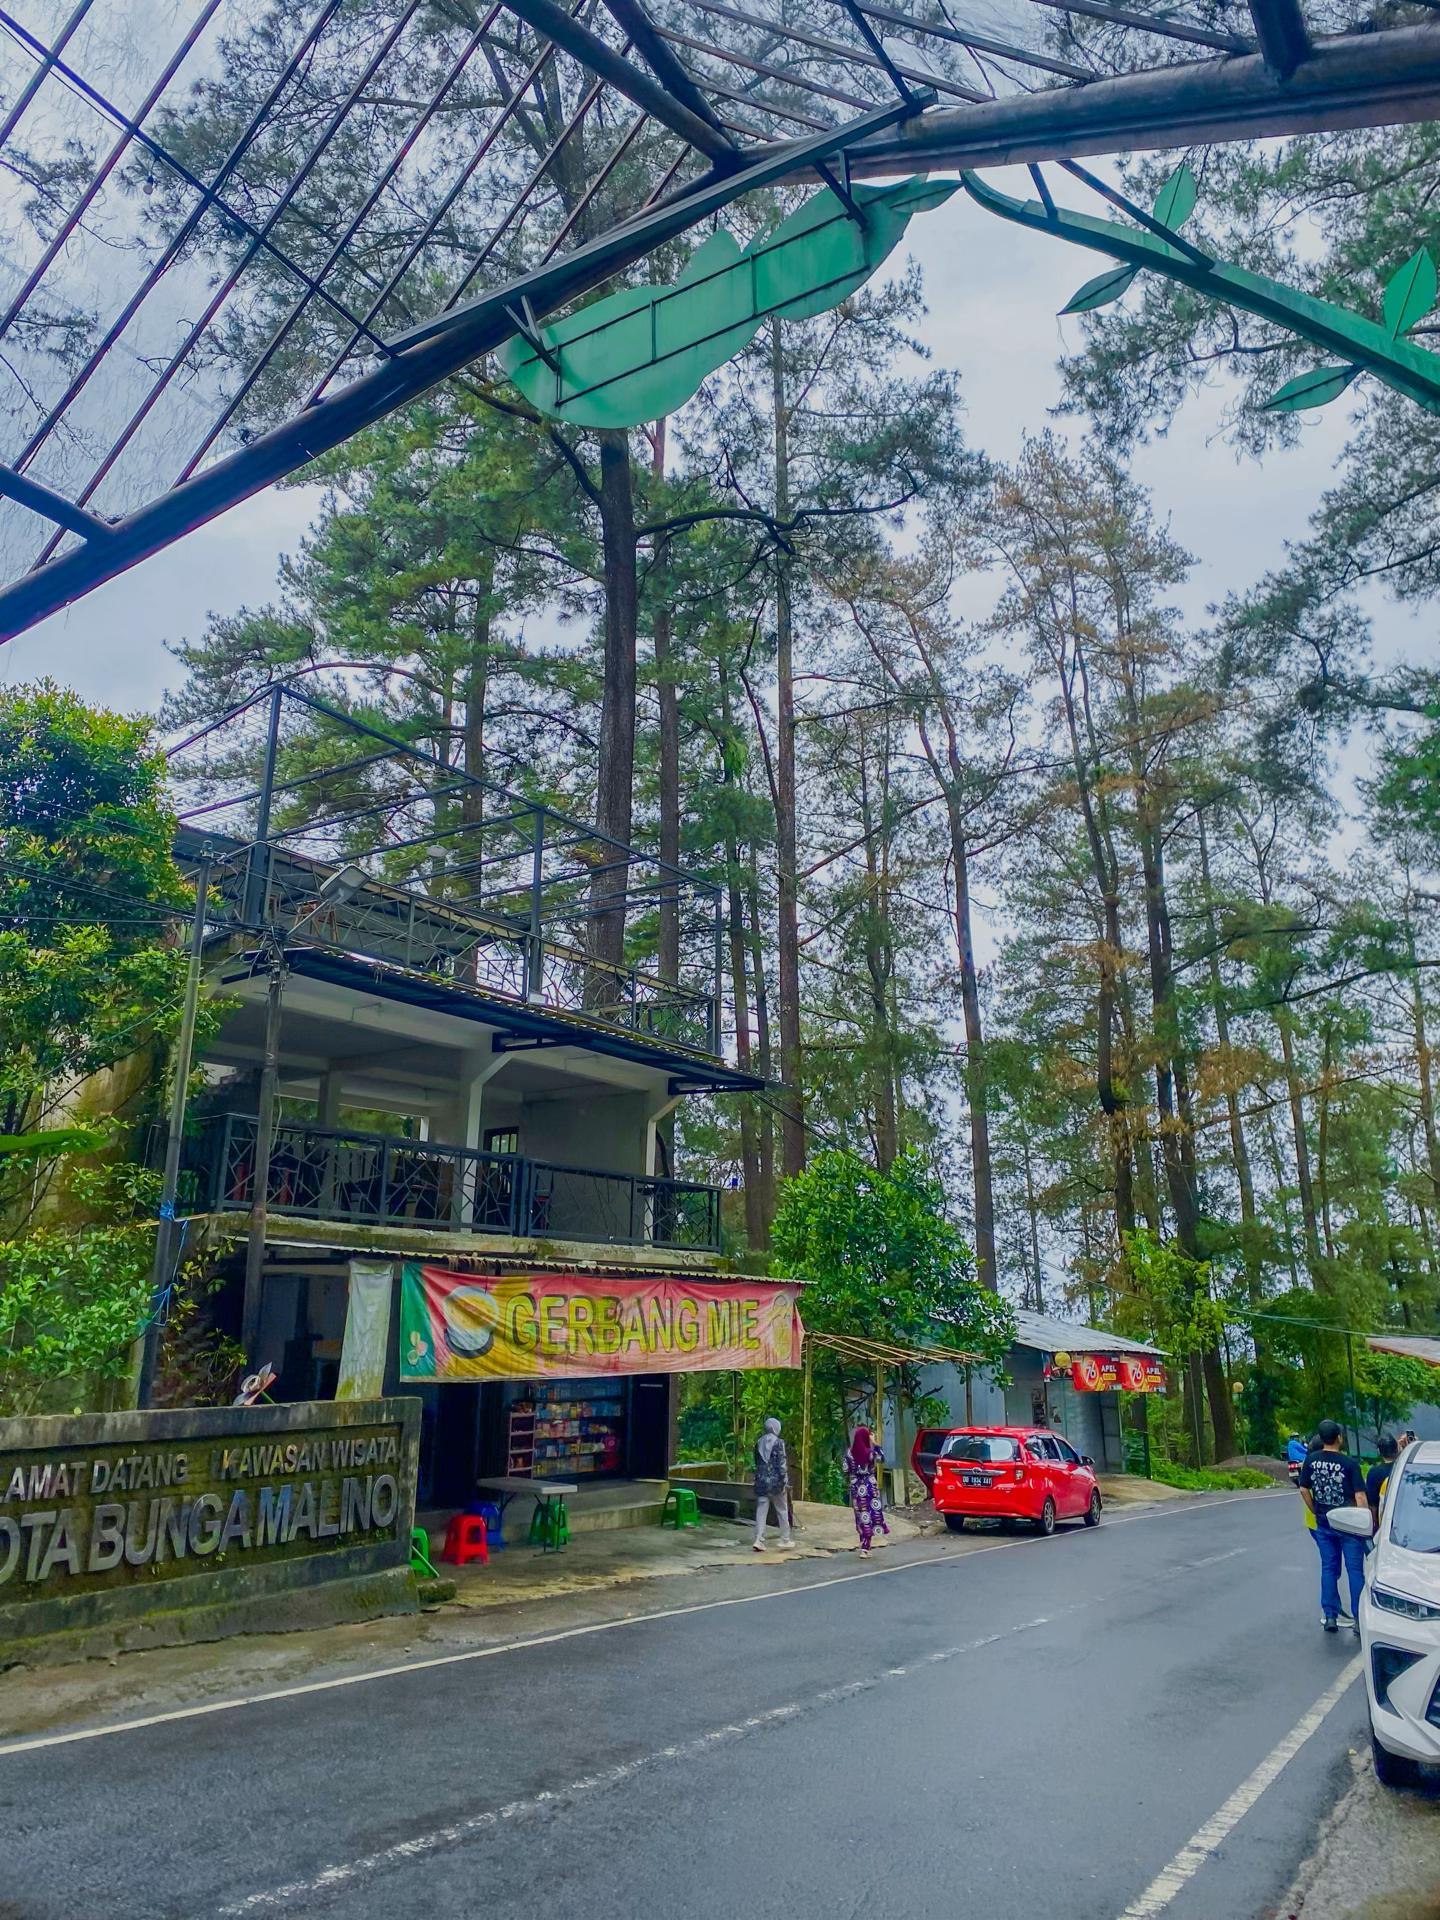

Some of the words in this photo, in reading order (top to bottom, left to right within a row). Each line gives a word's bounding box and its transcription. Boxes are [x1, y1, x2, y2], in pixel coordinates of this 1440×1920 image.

[504, 1292, 699, 1355] GERBANG
[706, 1298, 761, 1351] MIE
[1101, 1364, 1117, 1373] APEL
[1146, 1367, 1161, 1375] APEL
[0, 1462, 87, 1503] AMAT
[90, 1453, 188, 1494] DATANG
[221, 1443, 326, 1481] KAWASAN
[331, 1436, 399, 1470] WISATA
[1311, 1460, 1341, 1471] TOKYO
[88, 1489, 253, 1572] BUNGA
[256, 1473, 399, 1547] MALINO
